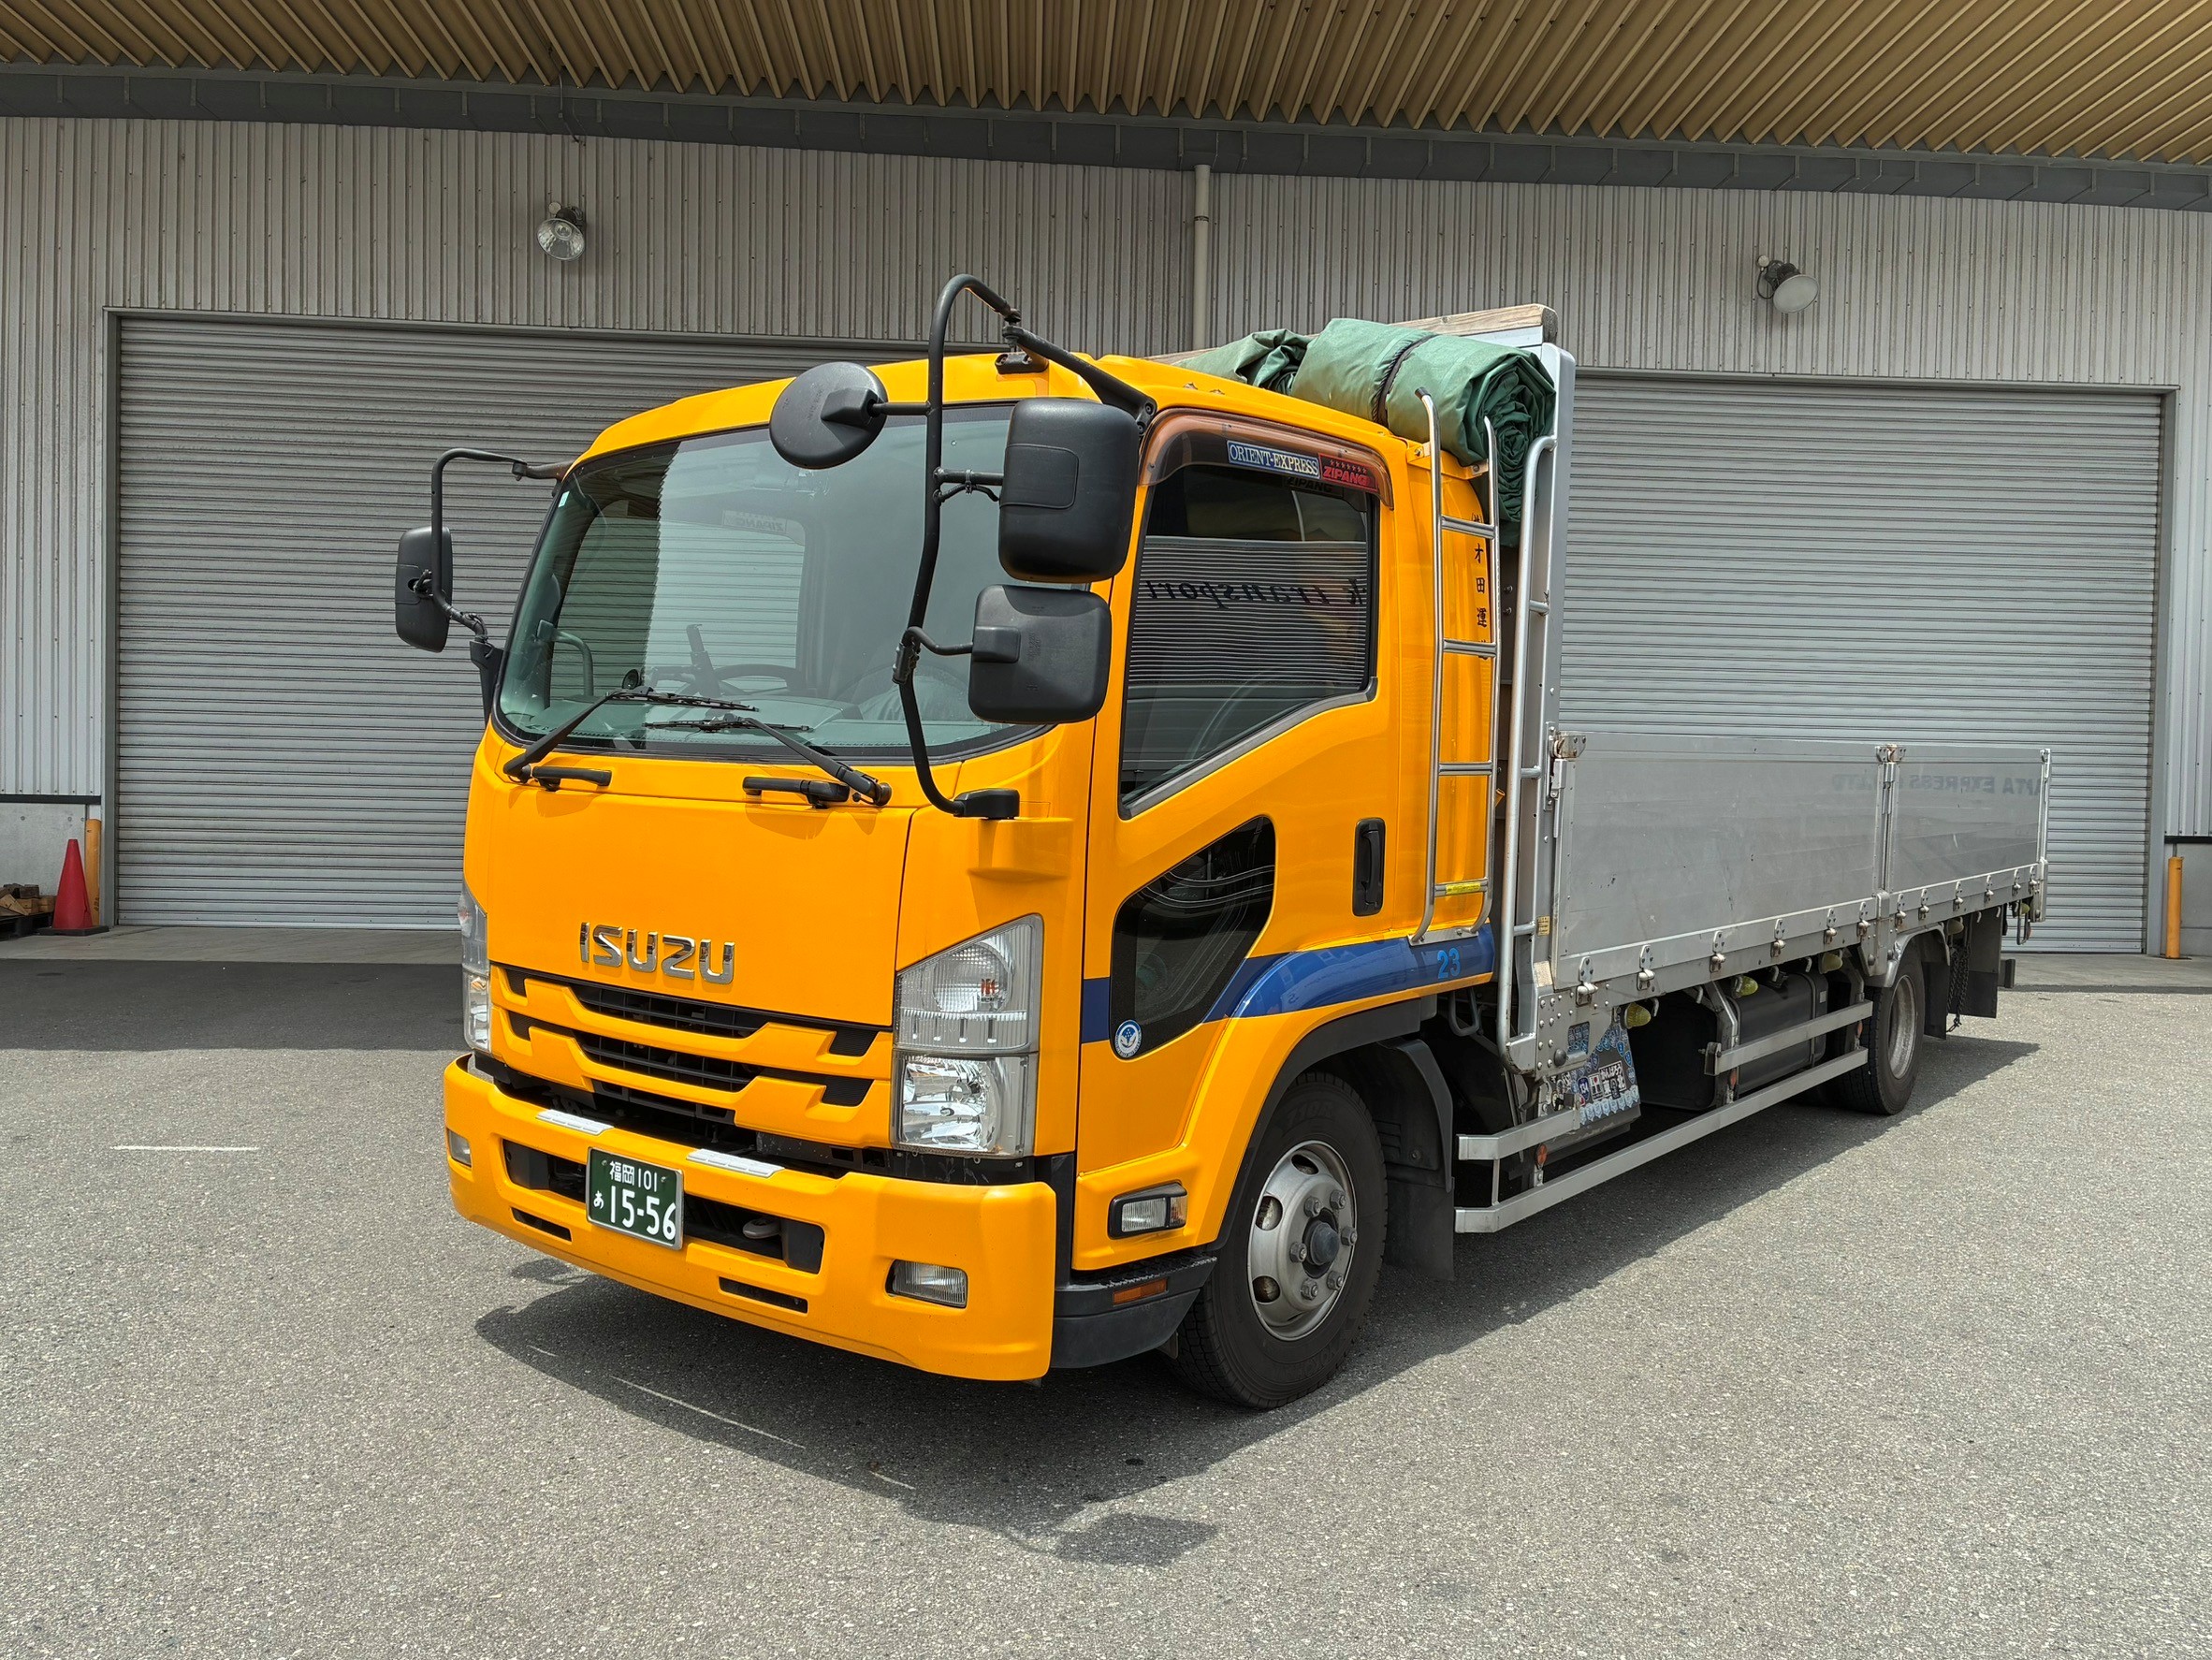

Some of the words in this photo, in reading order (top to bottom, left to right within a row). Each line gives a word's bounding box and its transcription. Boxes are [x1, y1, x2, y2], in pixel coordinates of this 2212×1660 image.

[1229, 444, 1318, 475] ORIENT-EXPRESS
[1323, 466, 1370, 486] ZIPANG
[579, 922, 735, 985] ISUZU
[1436, 947, 1461, 979] 23
[609, 1160, 635, 1187] 福岡
[637, 1168, 658, 1192] 101
[593, 1190, 604, 1210] あ
[610, 1186, 677, 1241] 15-56
